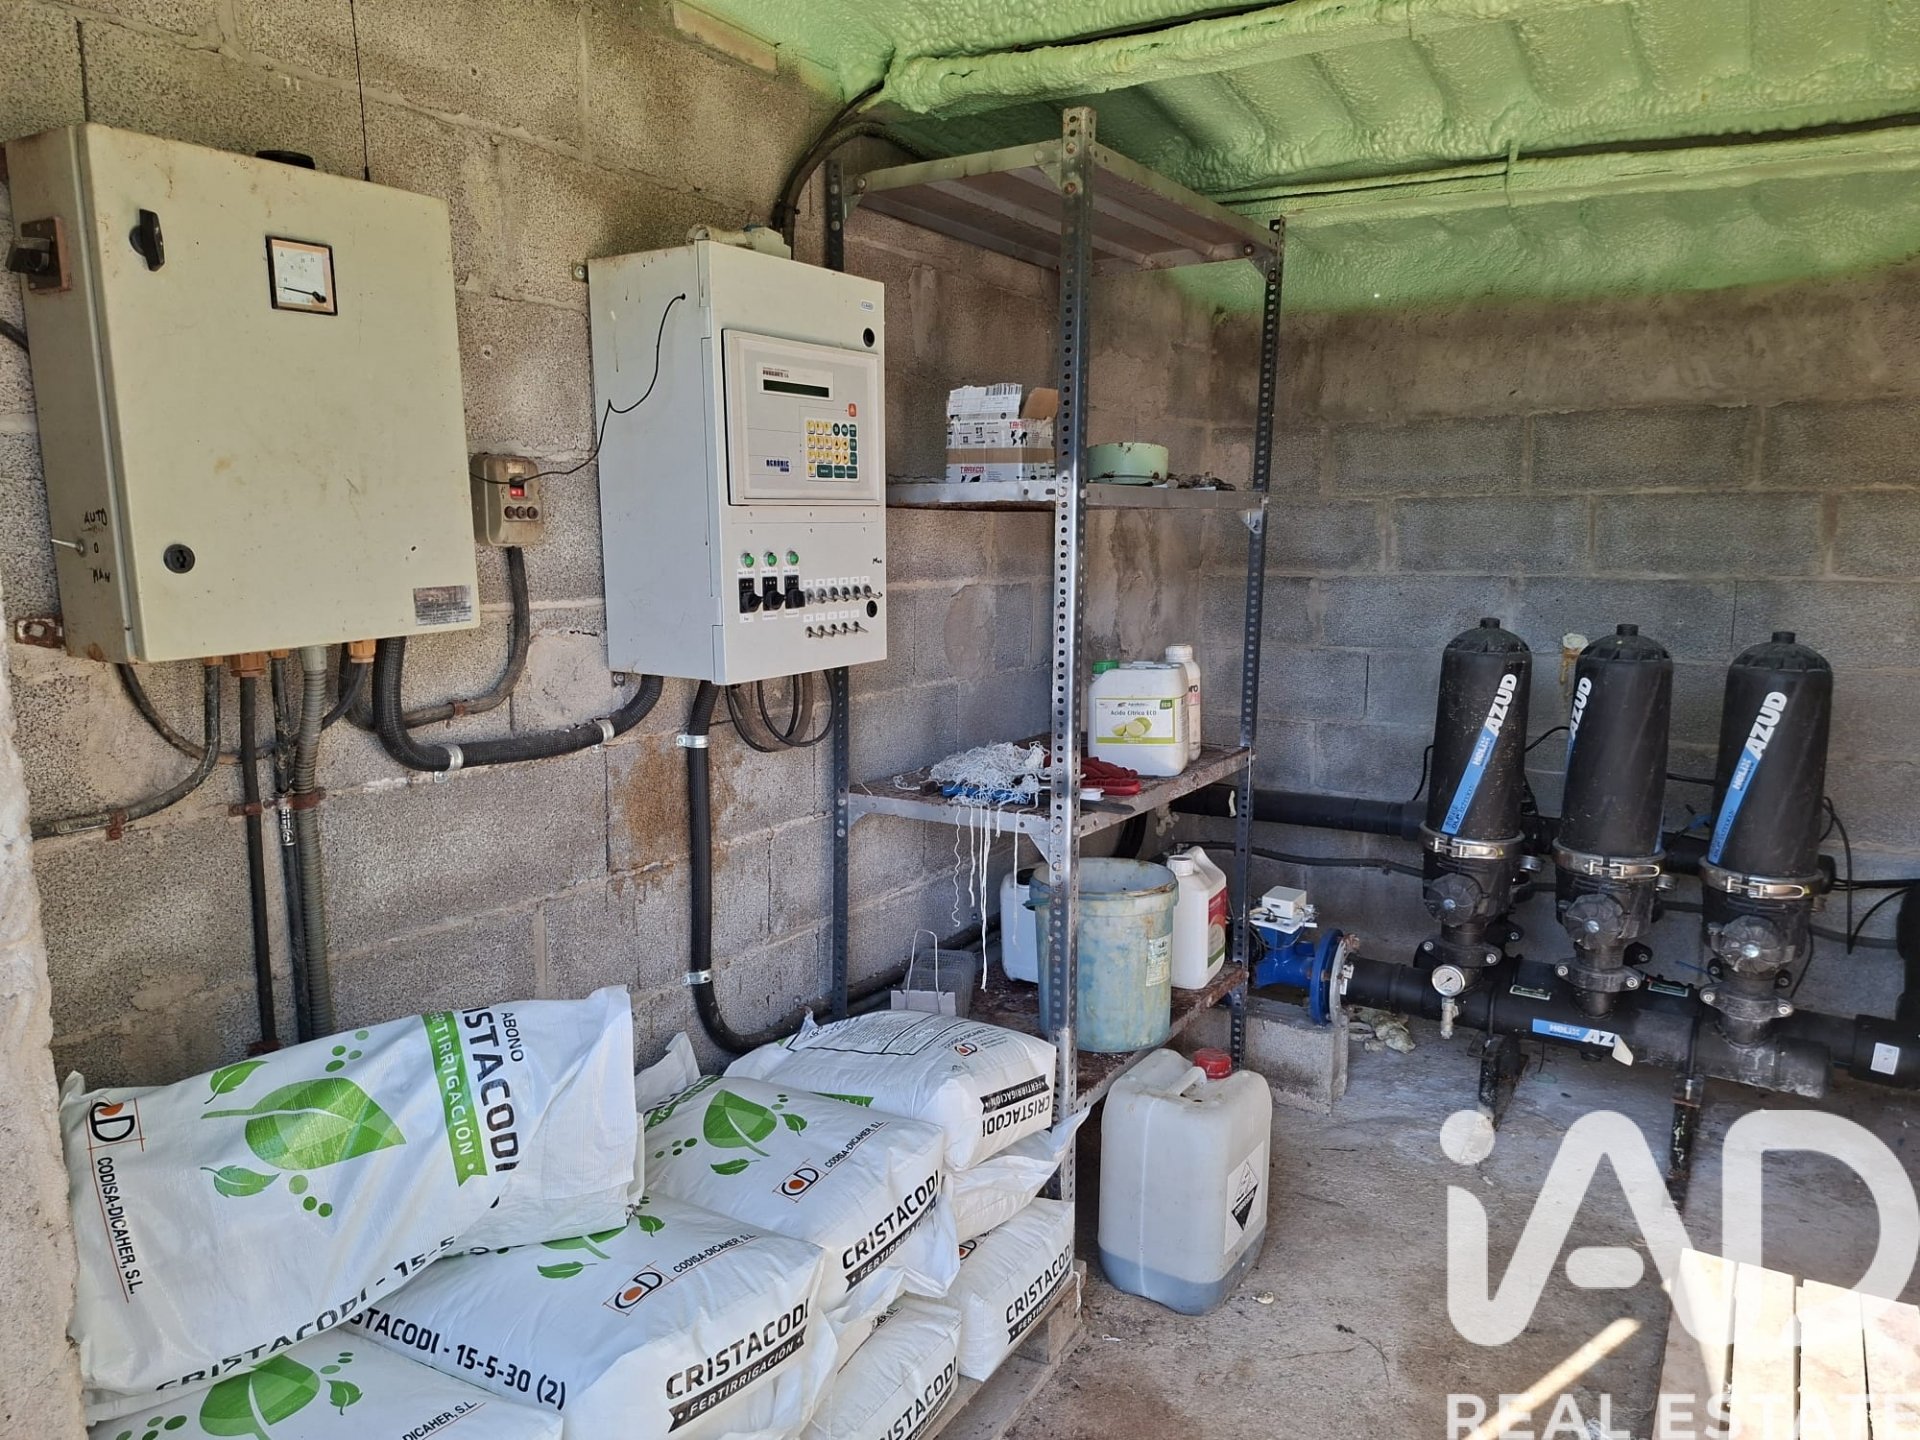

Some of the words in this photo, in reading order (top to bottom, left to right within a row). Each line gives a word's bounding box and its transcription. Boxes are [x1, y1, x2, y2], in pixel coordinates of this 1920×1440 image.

[84, 508, 107, 526] AUTO
[1485, 673, 1517, 737] AZUD
[1570, 677, 1592, 740] AZUD
[1745, 691, 1787, 760] AZUD
[501, 1012, 524, 1062] ABONO
[1582, 1029, 1615, 1048] AZ
[463, 1007, 520, 1172] ISTACODI
[981, 1095, 1050, 1138] CRISTACODI
[97, 1157, 136, 1269] CODISA-DICAHER,
[125, 1269, 143, 1294] S.L.
[842, 1170, 939, 1270] CRISTACODI
[350, 1307, 440, 1354] STACODI
[457, 1344, 531, 1393] 15-5-30
[537, 1374, 566, 1411] (2)
[666, 1298, 809, 1400] CRISTACODI
[689, 1341, 794, 1417] FERTIRRIGACIÓN
[402, 1409, 459, 1440] DICAHER,
[454, 1401, 478, 1415] S.L.
[879, 1355, 957, 1440] ISTACODI
